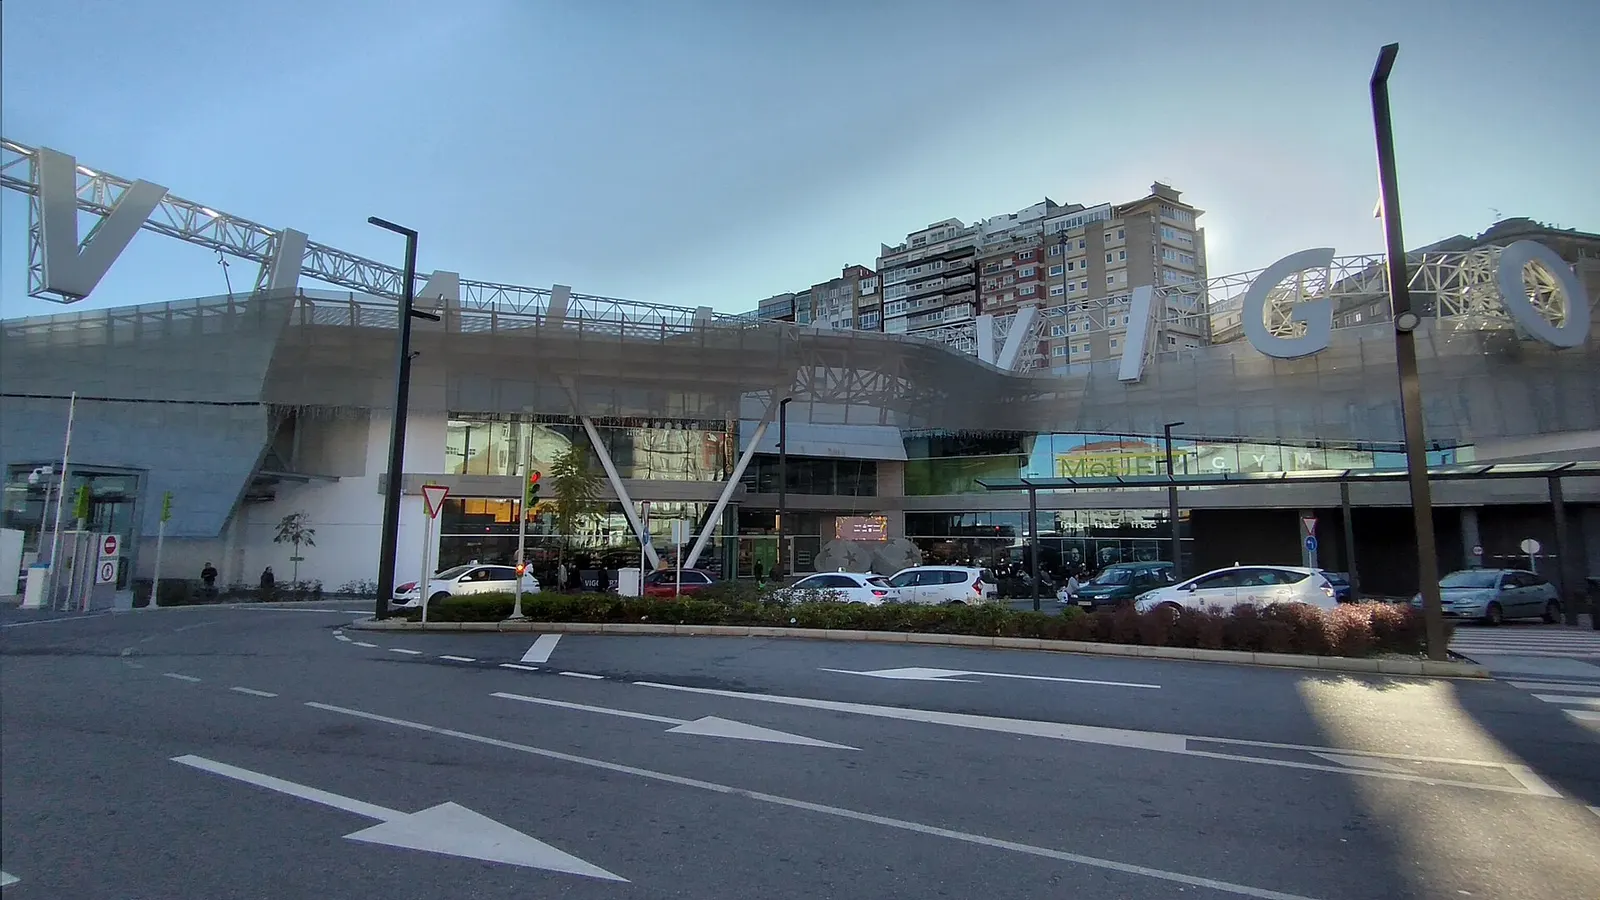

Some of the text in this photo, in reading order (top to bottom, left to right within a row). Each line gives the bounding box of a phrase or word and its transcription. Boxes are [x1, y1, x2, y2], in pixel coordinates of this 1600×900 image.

[975, 240, 1590, 384] VIGO
[1211, 452, 1313, 469] GYM
[1060, 520, 1157, 530] fnac fnac fnac
